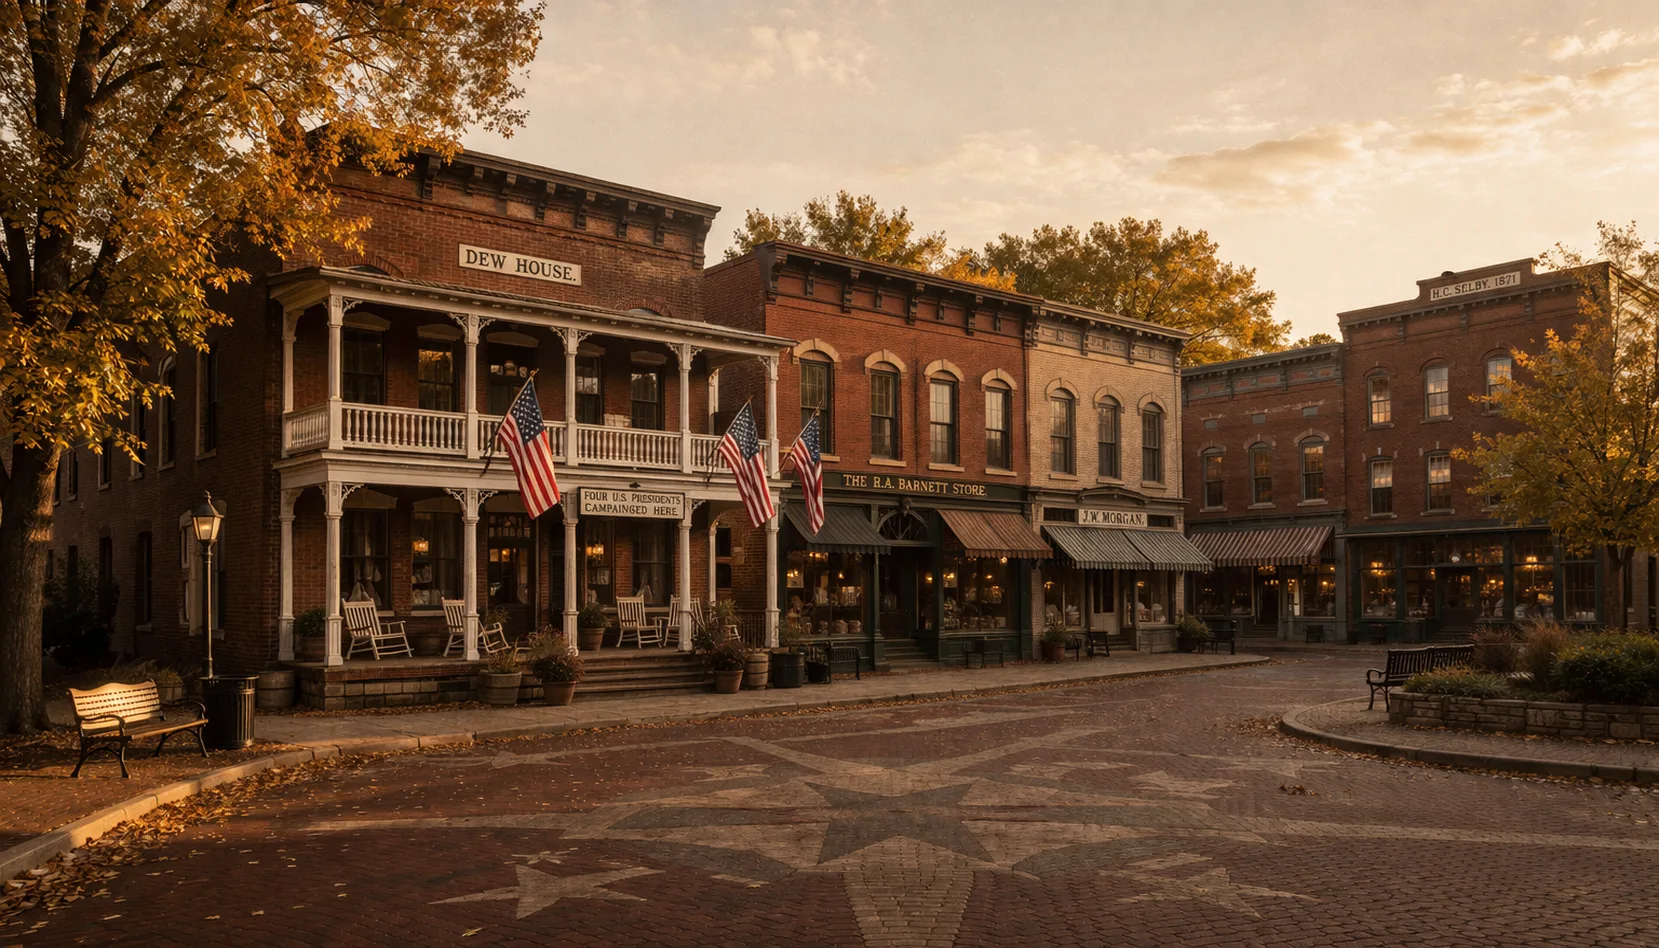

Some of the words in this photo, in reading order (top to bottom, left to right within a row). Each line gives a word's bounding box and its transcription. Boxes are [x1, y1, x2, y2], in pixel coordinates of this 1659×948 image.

[466, 249, 506, 269] DEW
[515, 258, 576, 281] HOUSE.
[1432, 288, 1452, 299] H.C.
[1495, 274, 1516, 286] 1871
[843, 474, 867, 487] THE
[873, 476, 895, 489] R.A.
[898, 478, 948, 493] BARNETT
[584, 491, 608, 501] FOUR
[612, 493, 627, 502] U.S.
[1083, 510, 1100, 523] J.W.
